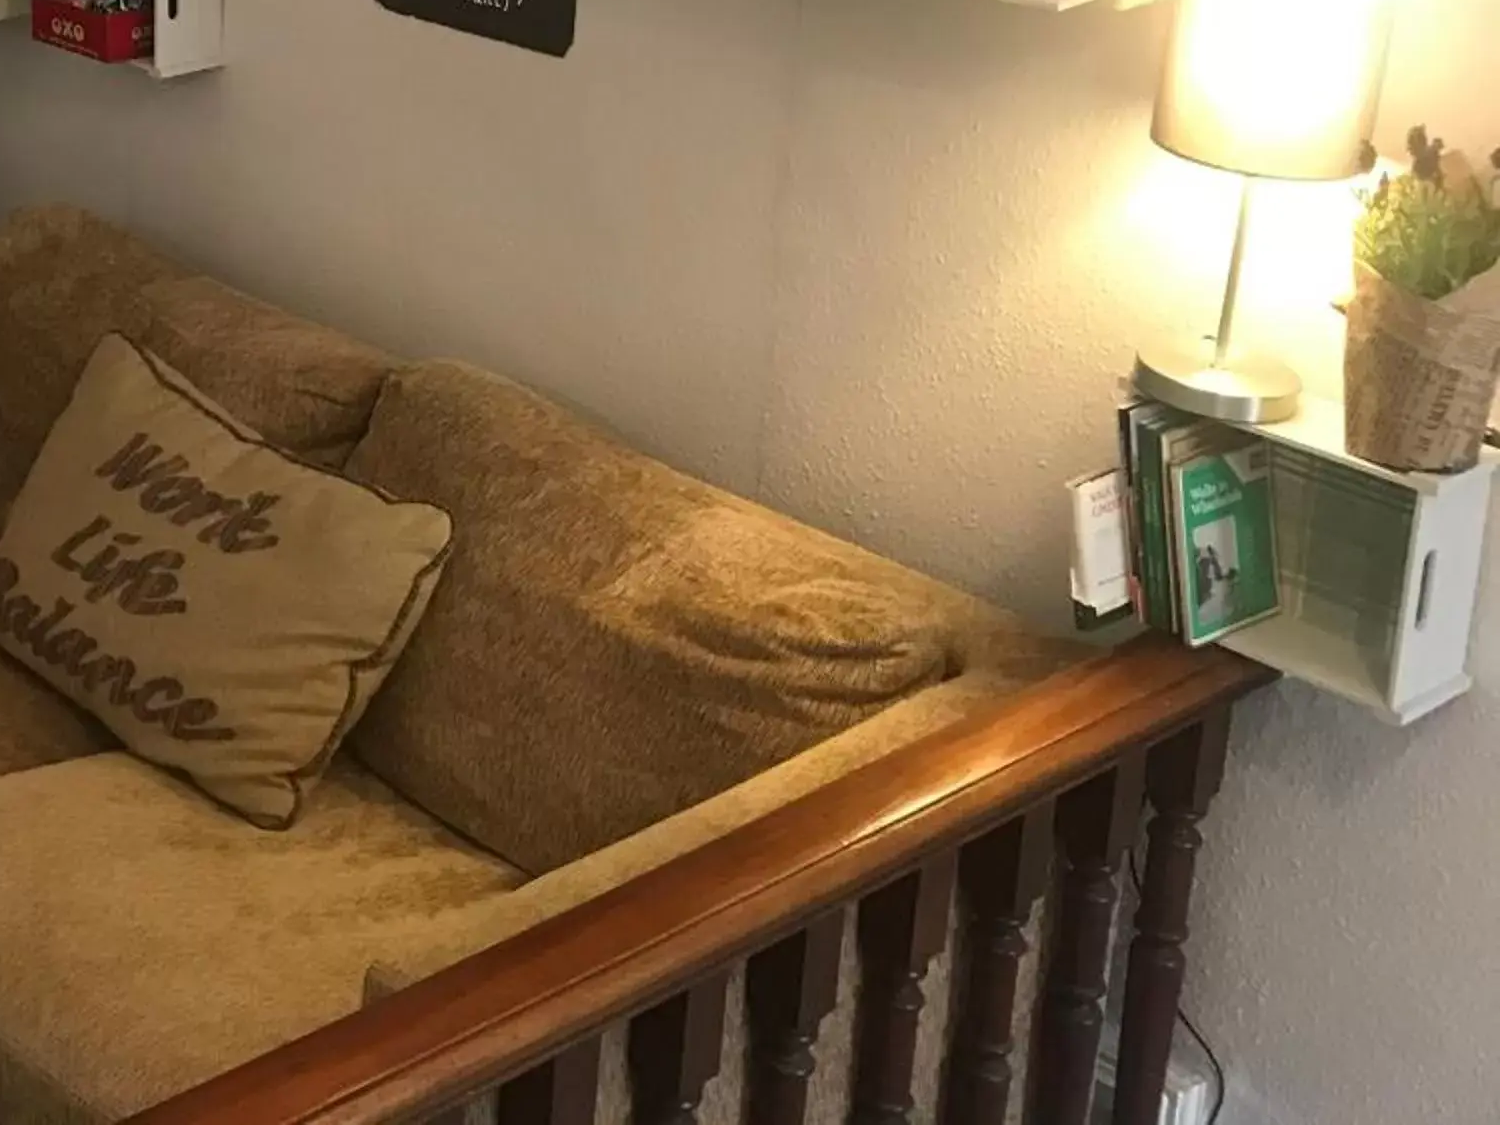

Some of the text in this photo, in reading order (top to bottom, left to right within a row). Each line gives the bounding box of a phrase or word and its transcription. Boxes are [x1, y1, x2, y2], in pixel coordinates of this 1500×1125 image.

[51, 16, 85, 42] OXO
[96, 432, 282, 555] Work
[50, 515, 187, 616] Life
